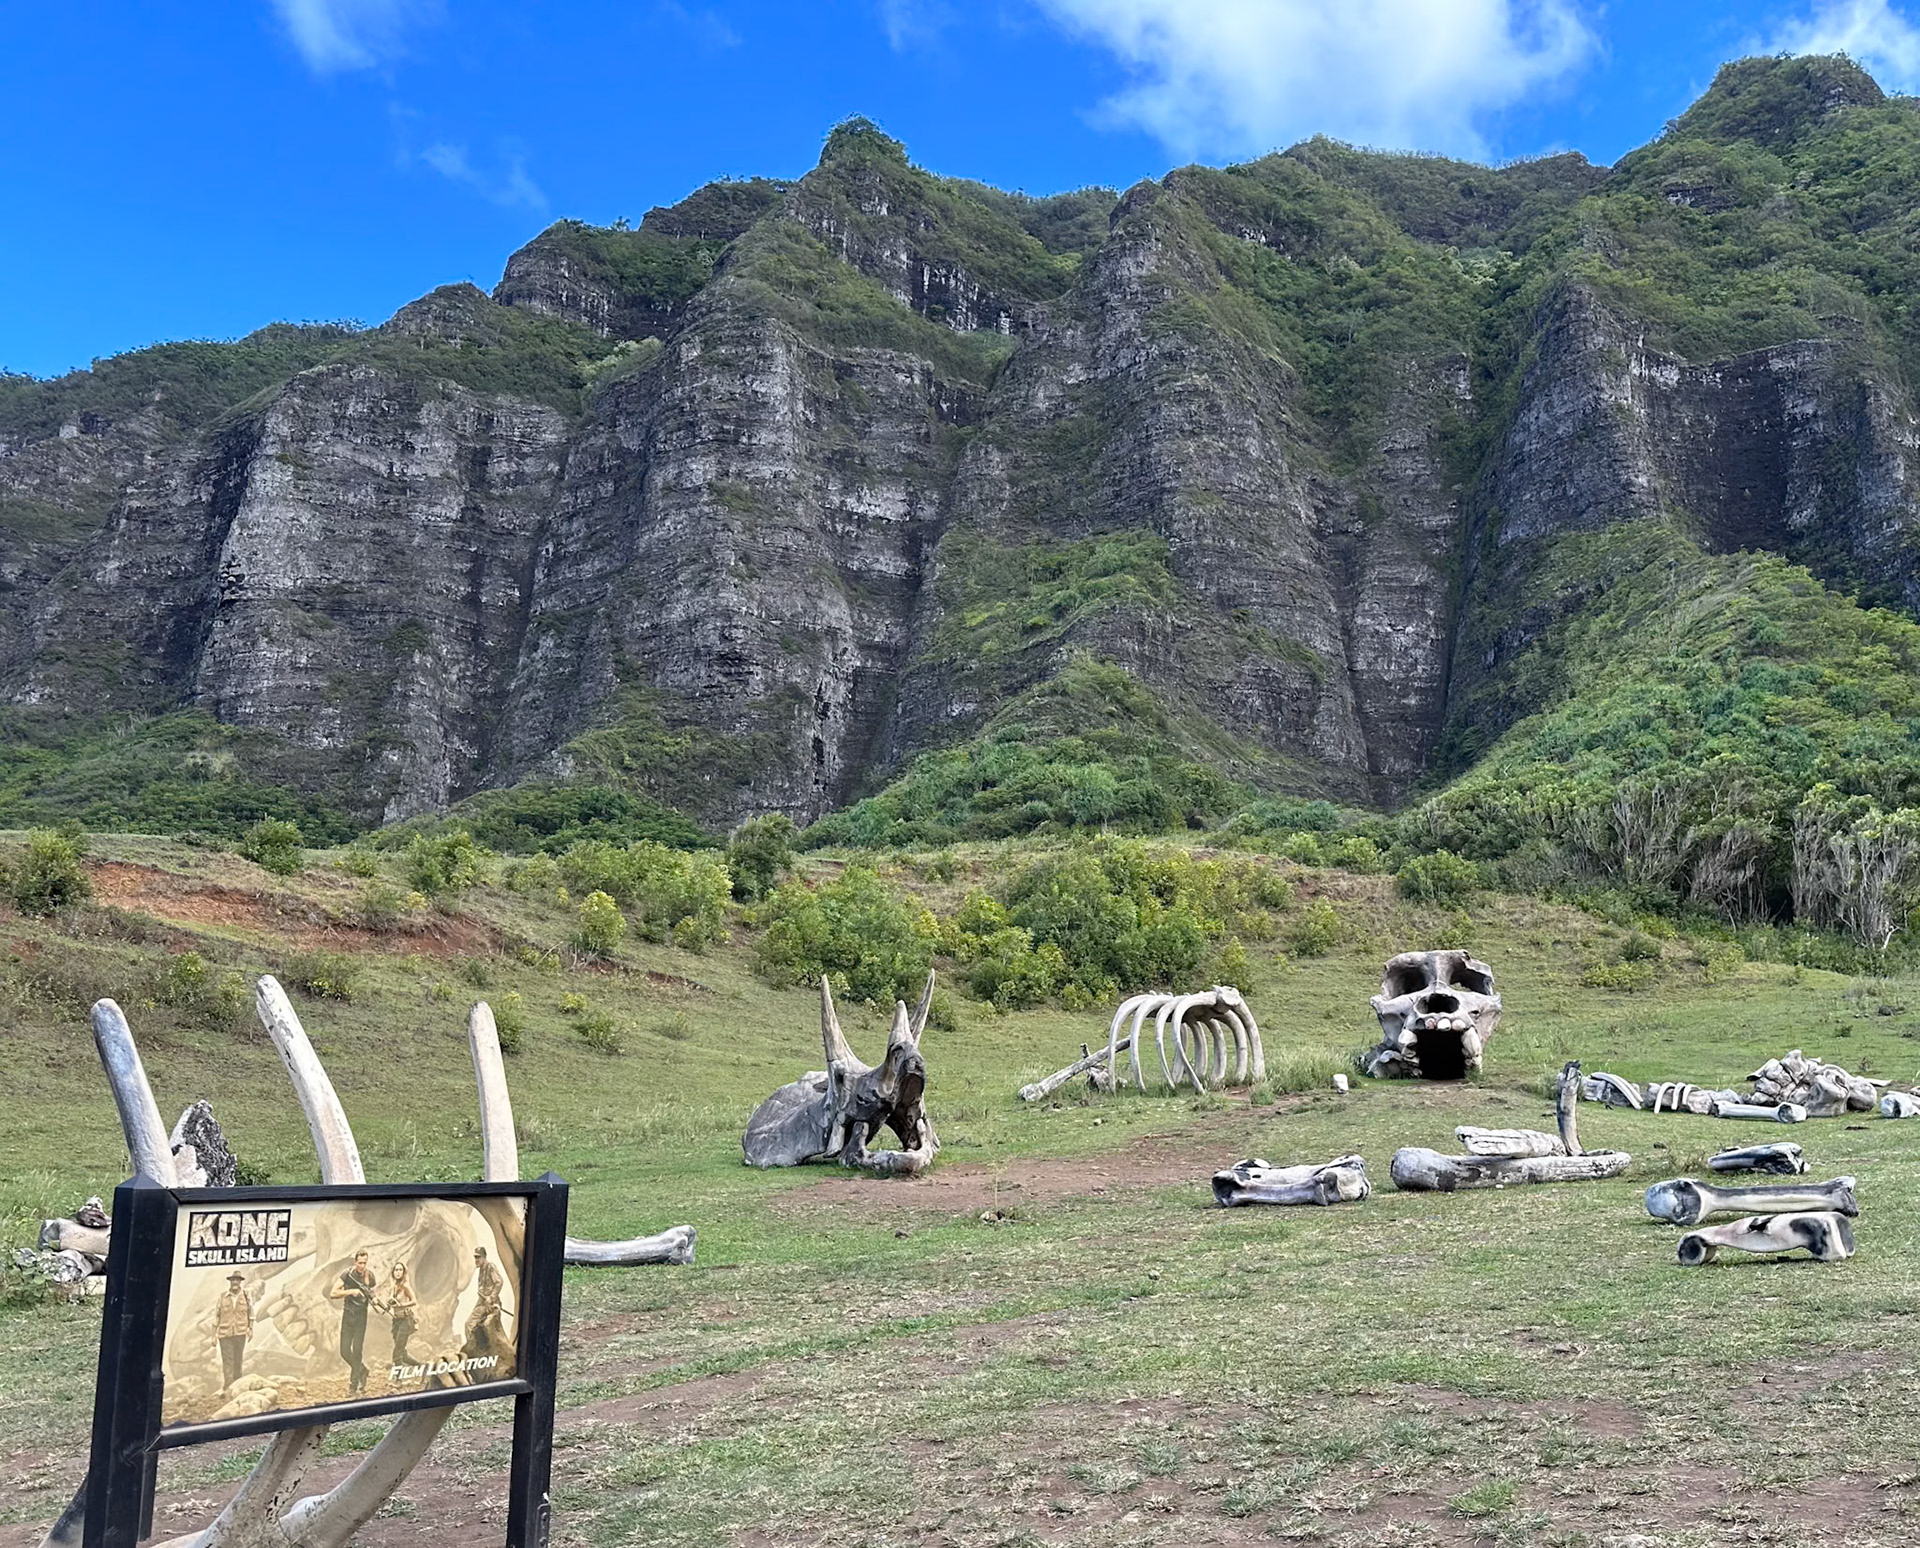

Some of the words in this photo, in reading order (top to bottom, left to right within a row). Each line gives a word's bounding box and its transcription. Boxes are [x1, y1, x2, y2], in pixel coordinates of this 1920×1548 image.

[190, 1212, 289, 1248] KONG
[187, 1249, 234, 1265] SKULL
[235, 1247, 288, 1263] ISLAND
